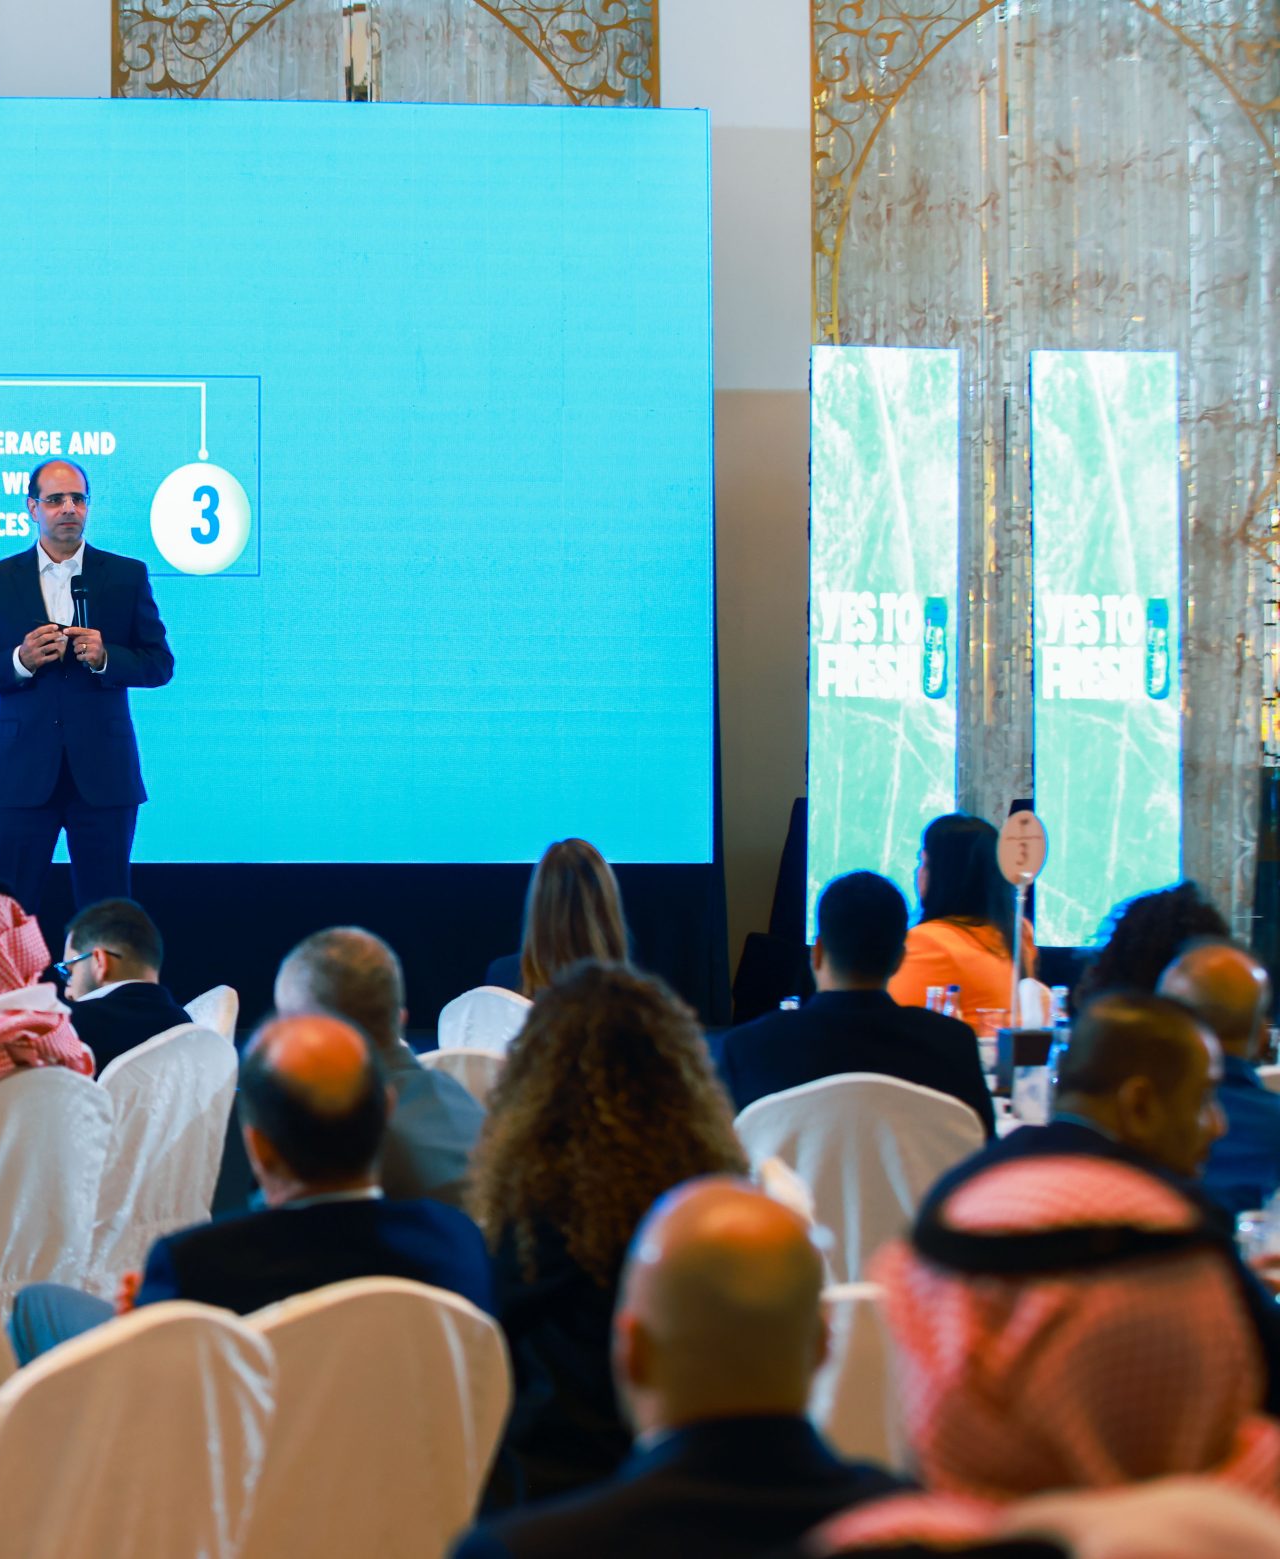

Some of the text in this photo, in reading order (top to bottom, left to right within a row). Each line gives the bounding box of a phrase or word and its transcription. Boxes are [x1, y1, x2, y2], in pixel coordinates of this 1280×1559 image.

[67, 431, 116, 455] AND
[191, 485, 220, 544] 3
[818, 591, 919, 644] YES TO
[1041, 594, 1143, 645] YES TO
[818, 644, 920, 698] FRESH
[1042, 646, 1144, 700] FRESH
